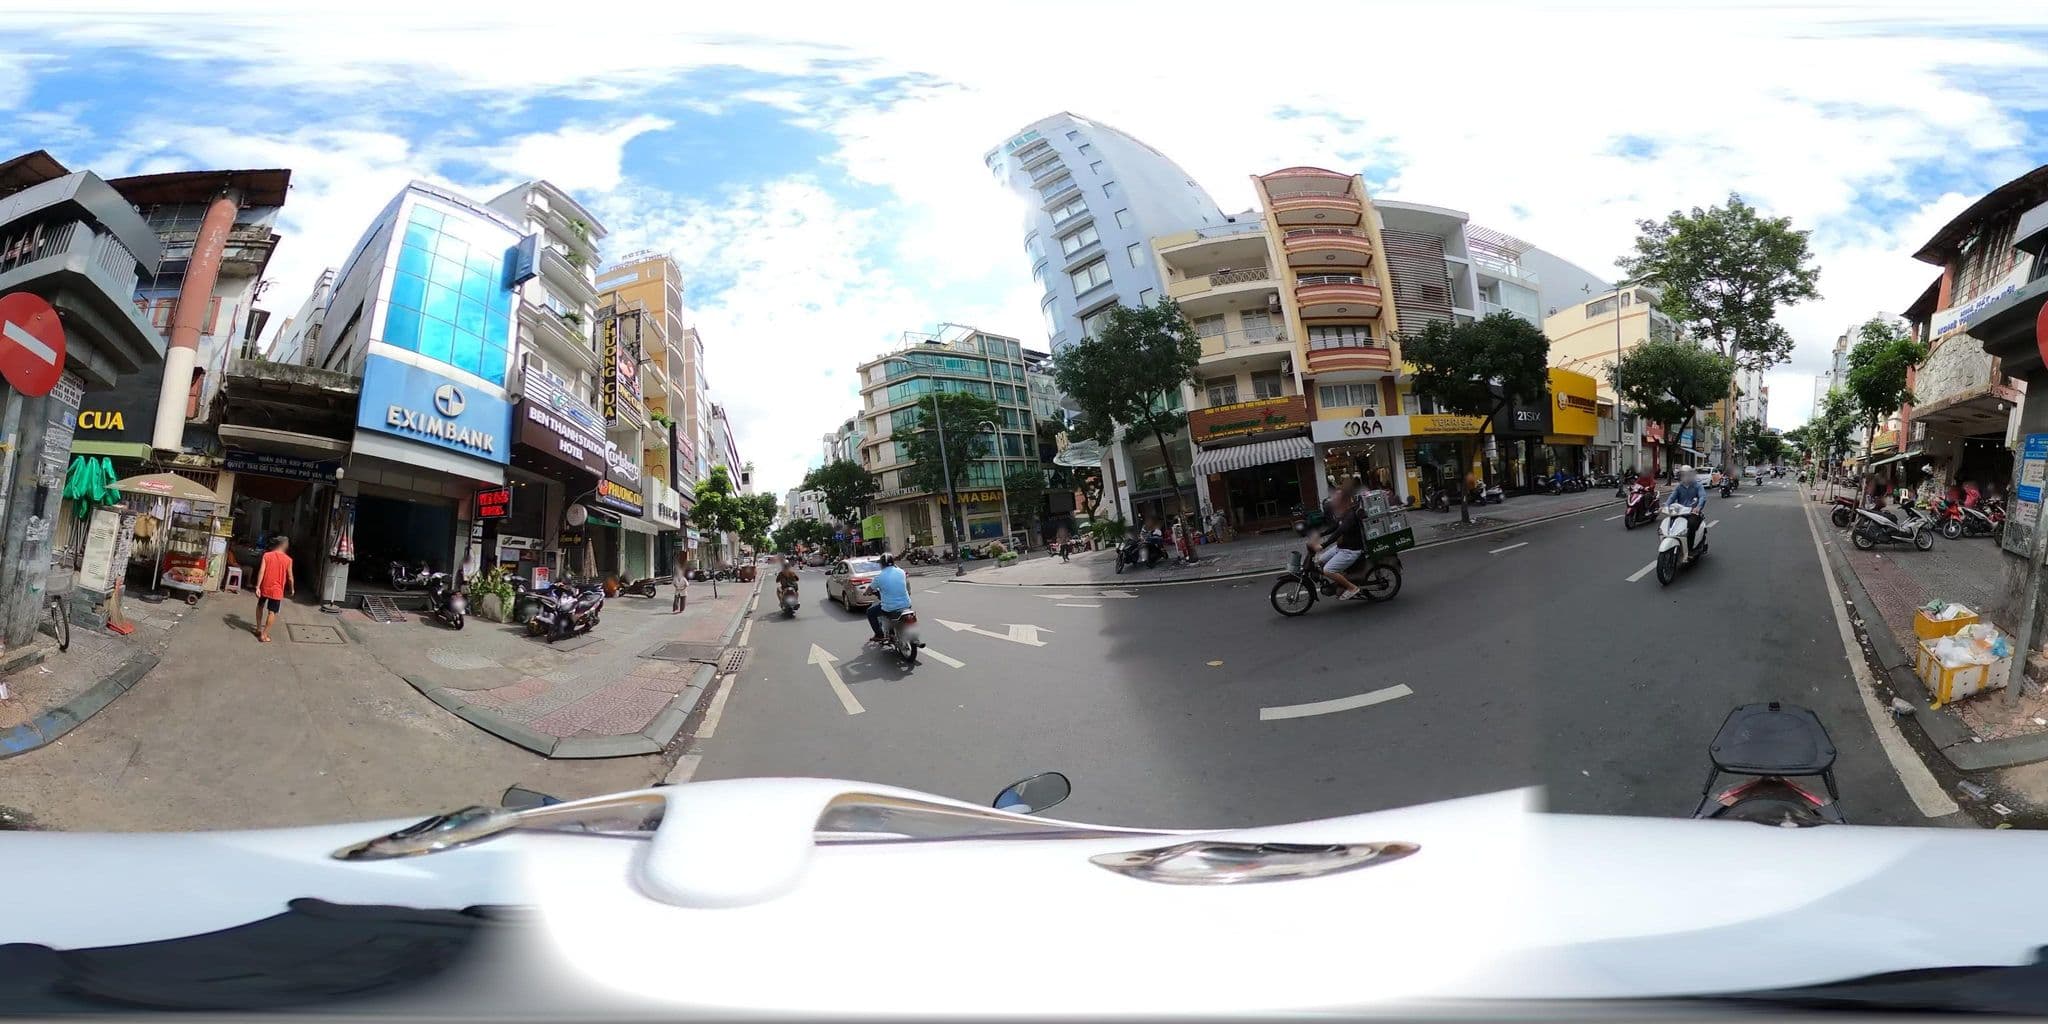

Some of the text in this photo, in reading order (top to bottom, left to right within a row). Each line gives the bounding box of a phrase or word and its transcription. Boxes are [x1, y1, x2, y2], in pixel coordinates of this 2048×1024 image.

[78, 412, 125, 432] CUA
[528, 406, 550, 427] BEN
[387, 405, 494, 453] EXIMBANK
[1344, 419, 1383, 437] COBA
[558, 439, 584, 461] HOTEL
[605, 440, 639, 479] Carlsberg
